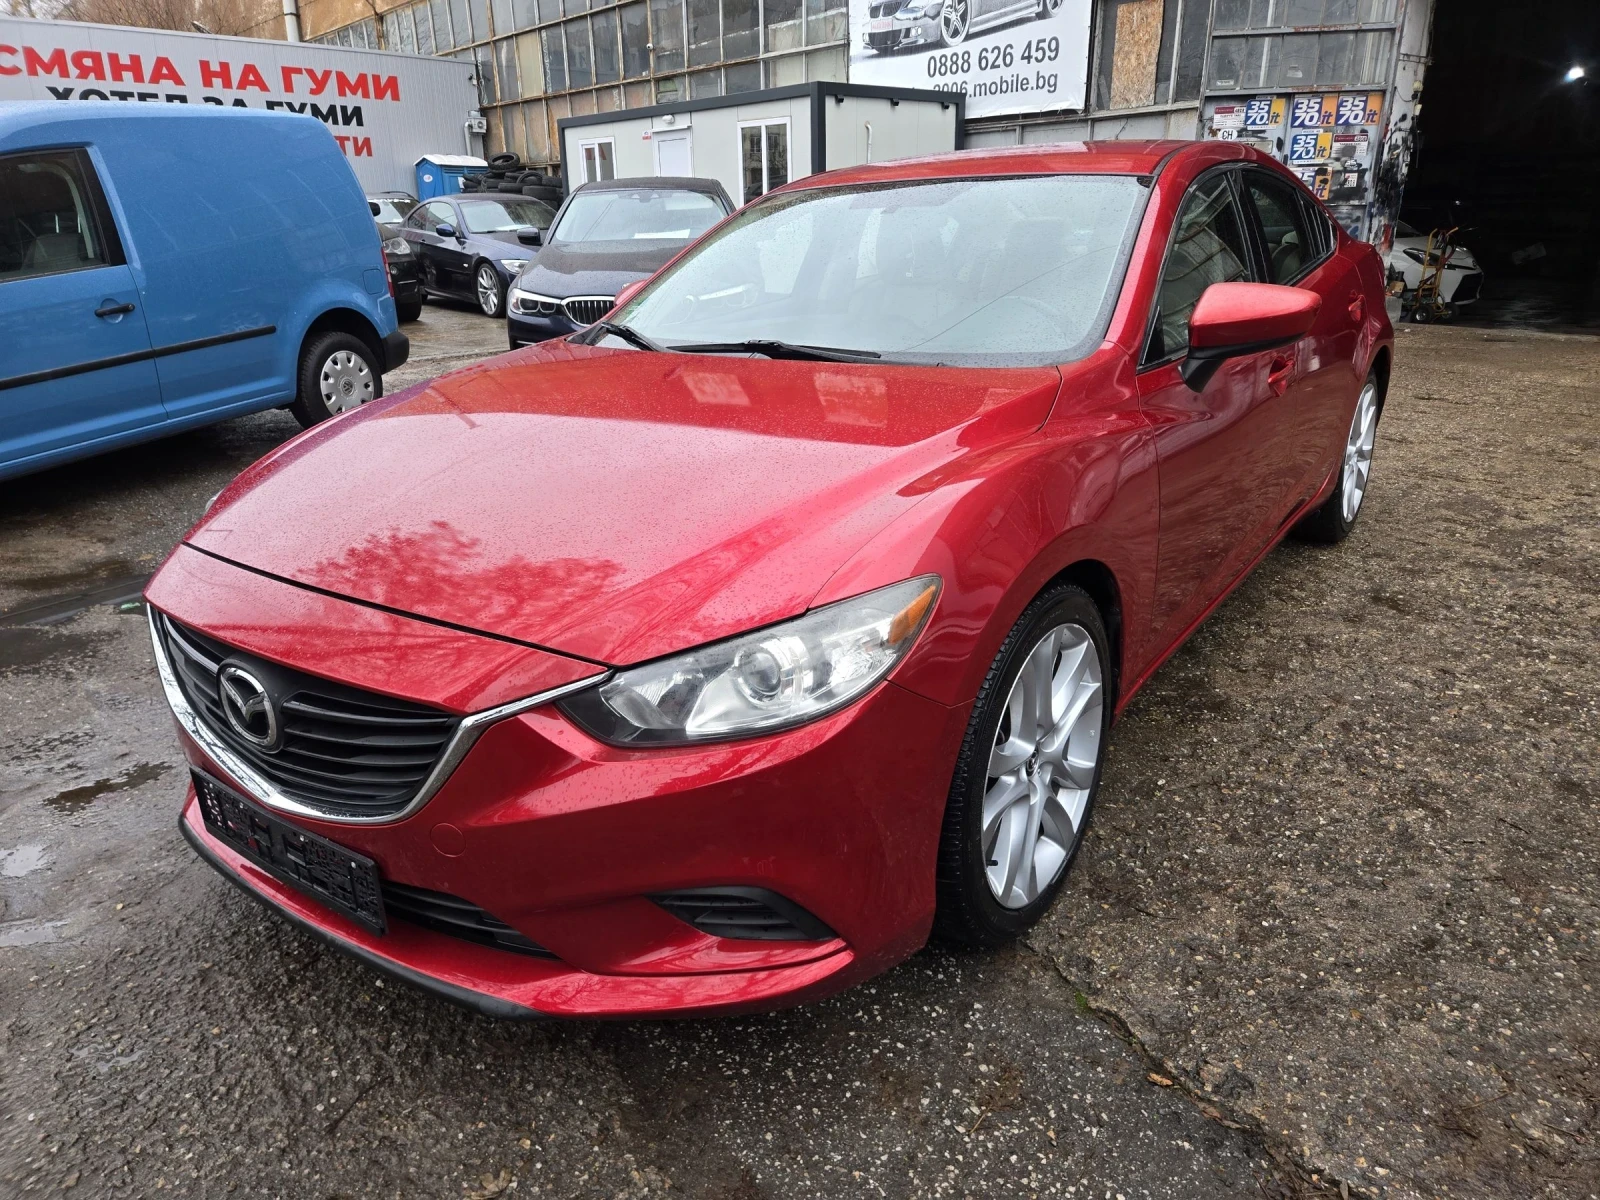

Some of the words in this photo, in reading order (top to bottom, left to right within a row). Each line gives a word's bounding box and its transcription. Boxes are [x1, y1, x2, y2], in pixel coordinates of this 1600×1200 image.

[927, 50, 971, 78] 0888
[978, 43, 1014, 71] 626
[1020, 36, 1060, 65] 459
[0, 43, 187, 87] СМЯНА
[198, 59, 271, 93] НА
[280, 65, 401, 102] ГУМИ
[1248, 100, 1270, 113] 35
[1294, 98, 1321, 113] 35
[1339, 96, 1366, 111] 35
[1293, 135, 1316, 148] 35
